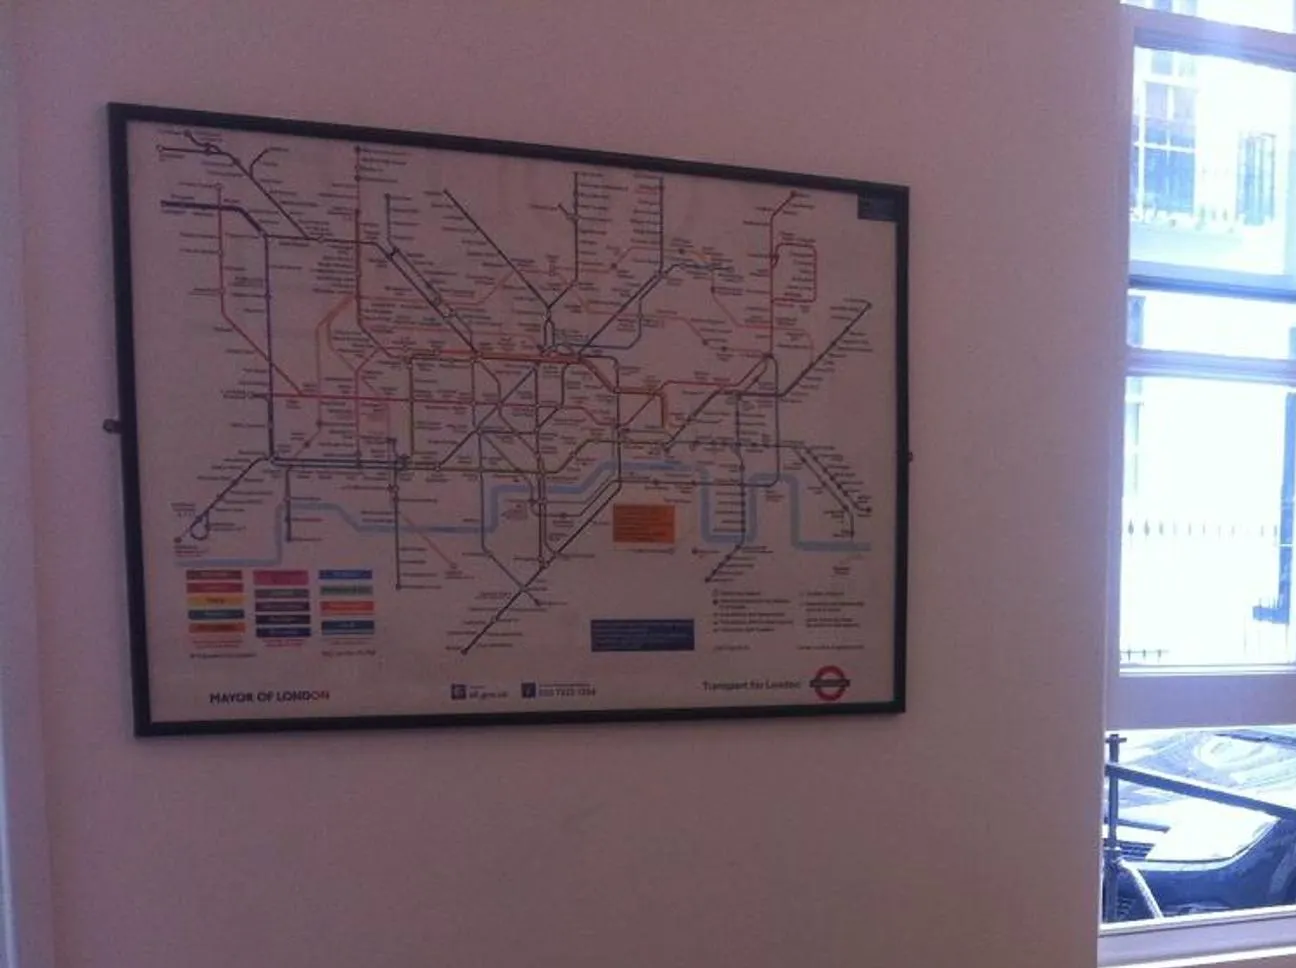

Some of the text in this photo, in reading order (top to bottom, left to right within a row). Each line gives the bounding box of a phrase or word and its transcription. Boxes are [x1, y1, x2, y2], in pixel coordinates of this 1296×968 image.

[209, 690, 330, 703] MAYOR OF LONDON
